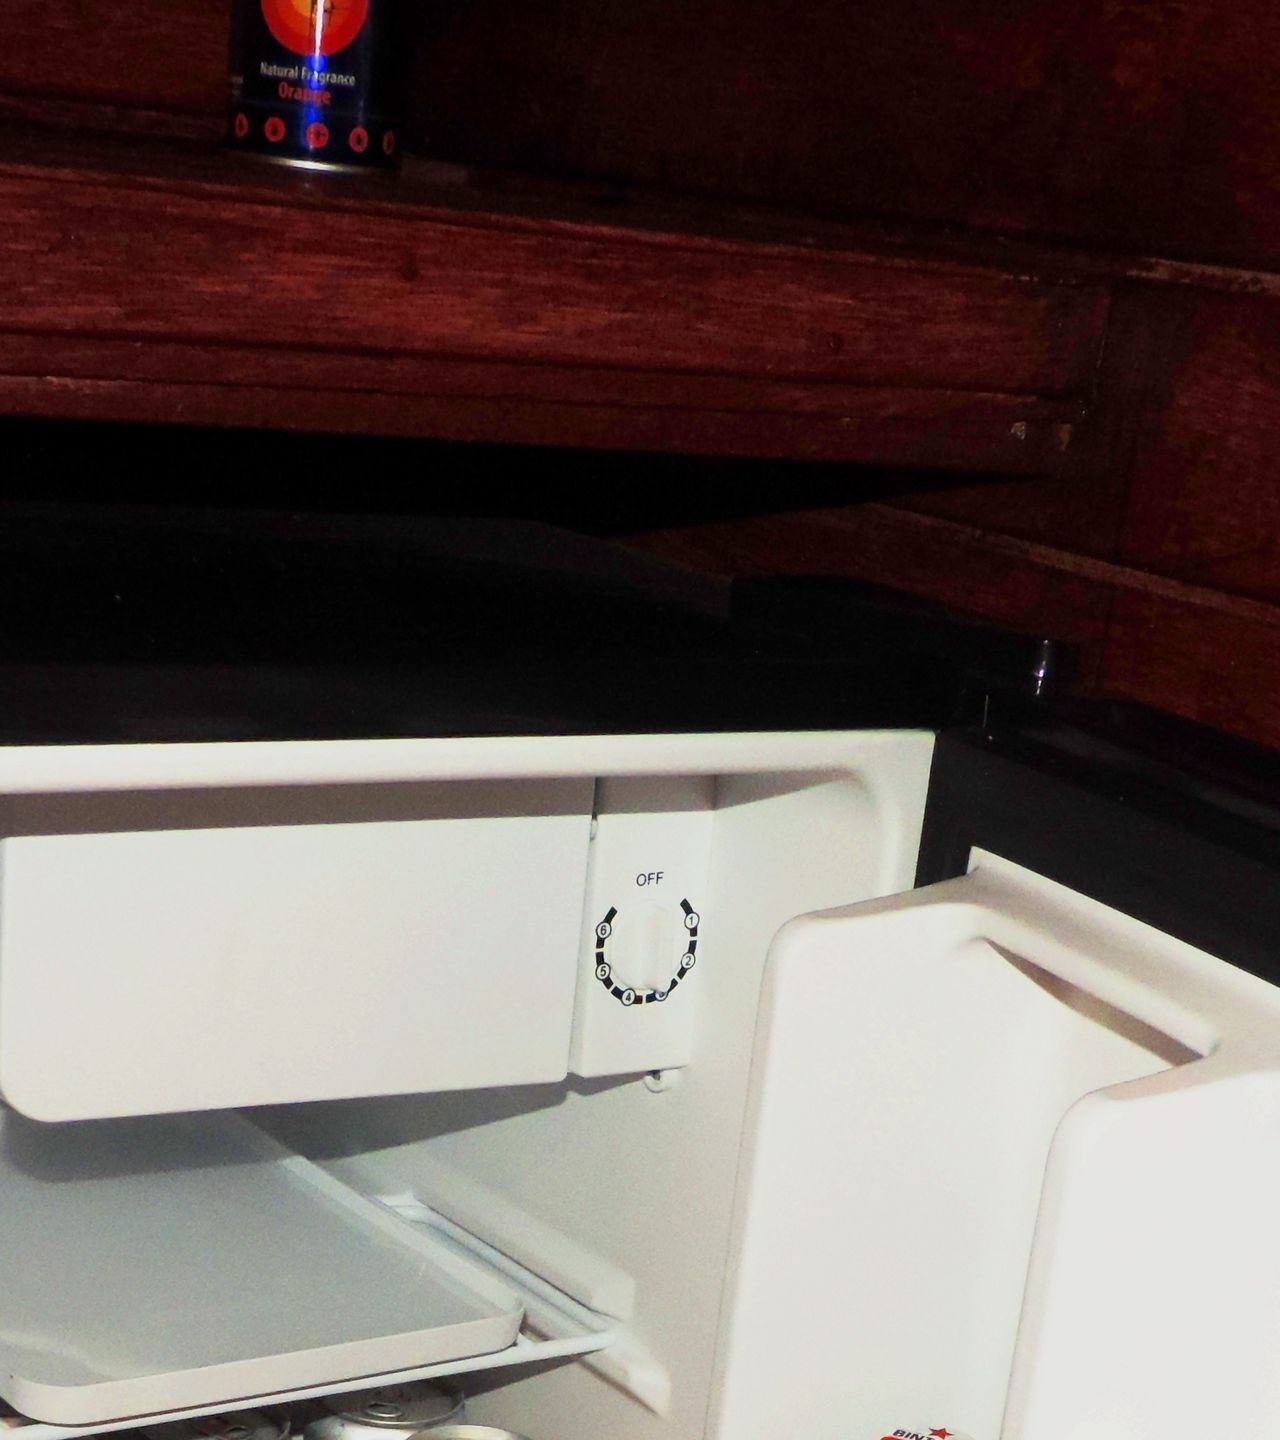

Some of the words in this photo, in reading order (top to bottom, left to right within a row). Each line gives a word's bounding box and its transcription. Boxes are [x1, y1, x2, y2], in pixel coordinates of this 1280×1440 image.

[260, 61, 299, 79] Natural
[301, 66, 356, 86] Fragrance
[277, 81, 333, 105] Orange
[636, 871, 665, 887] OFF
